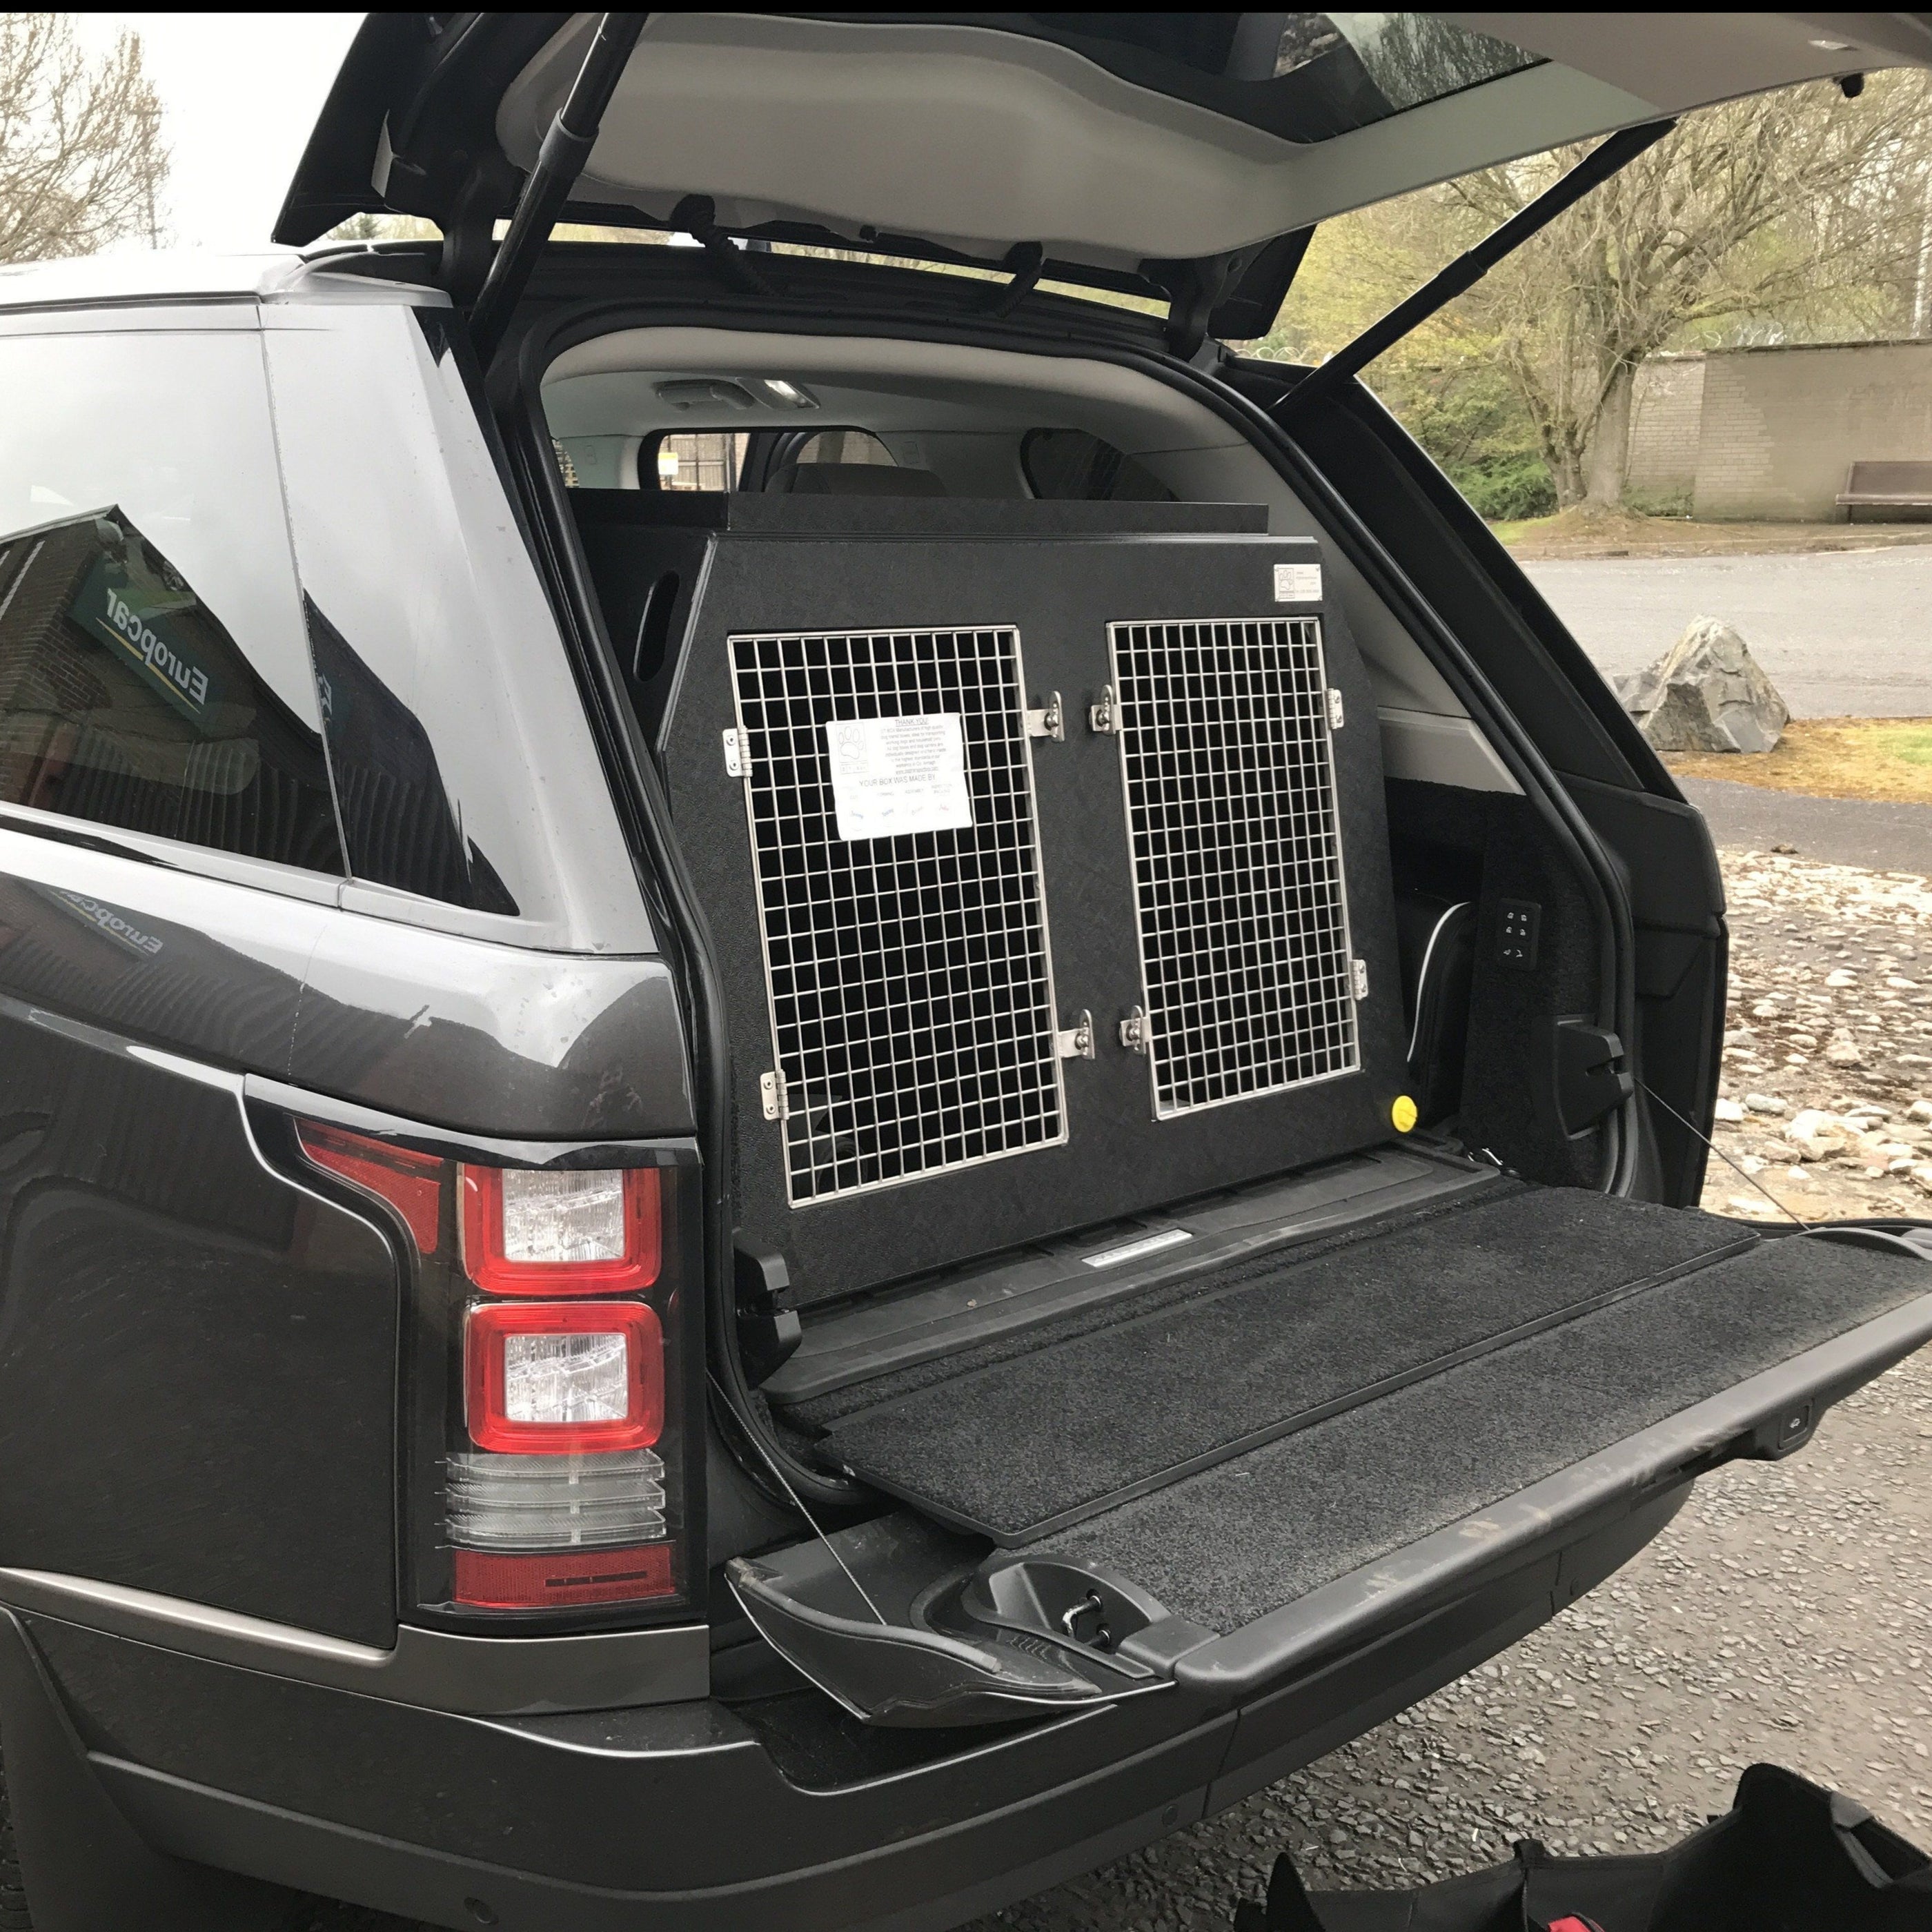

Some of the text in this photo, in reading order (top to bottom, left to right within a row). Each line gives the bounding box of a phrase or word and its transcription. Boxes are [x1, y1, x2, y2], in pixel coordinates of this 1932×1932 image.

[859, 778, 878, 787] YOUR
[879, 777, 893, 785] BOX
[894, 776, 908, 784] WAS
[909, 774, 927, 782] MADE
